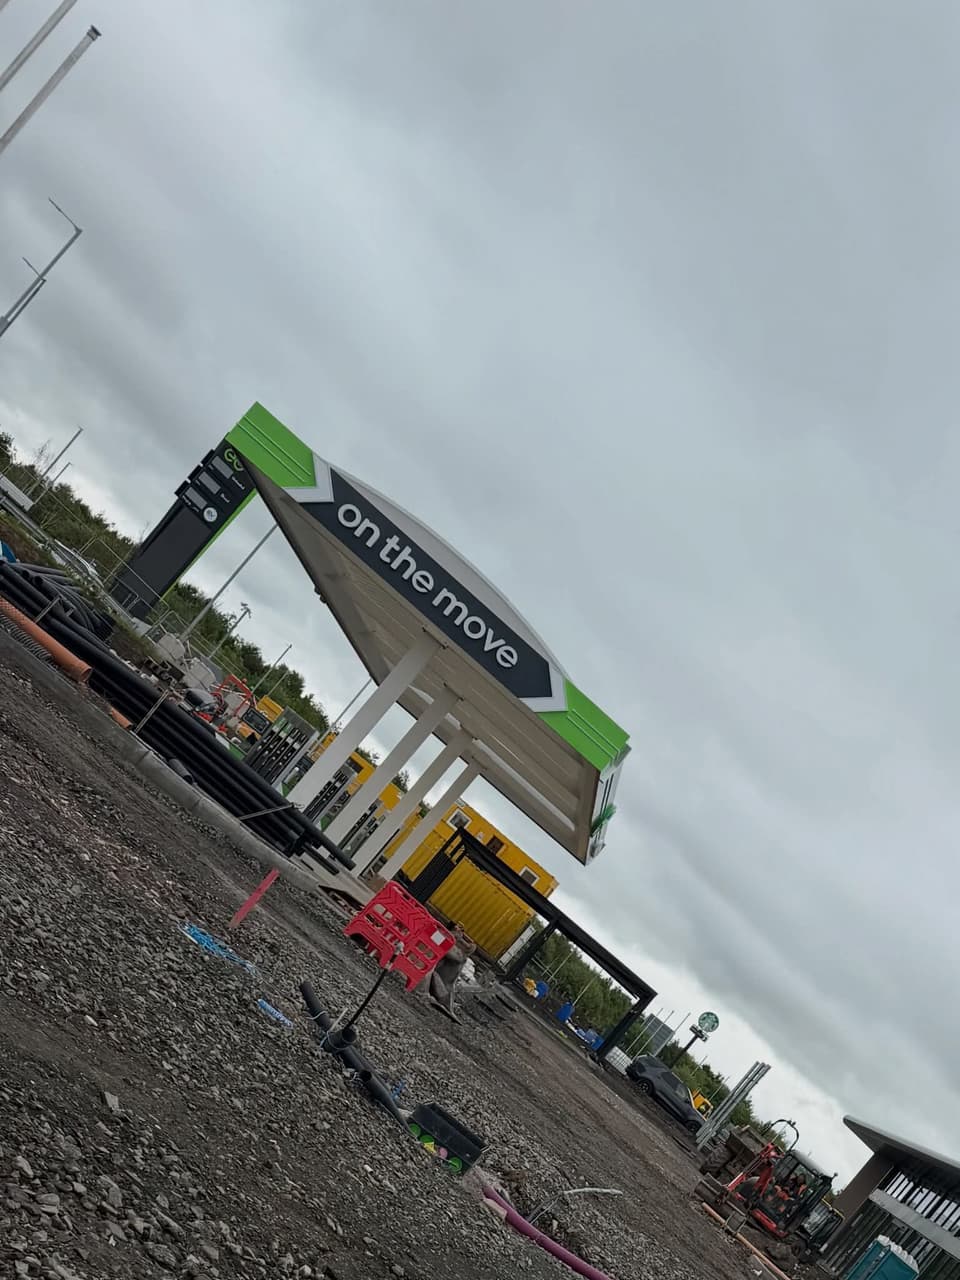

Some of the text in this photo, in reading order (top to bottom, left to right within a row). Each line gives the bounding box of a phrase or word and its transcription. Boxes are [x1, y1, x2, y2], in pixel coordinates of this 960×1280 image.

[337, 503, 518, 668] on the move
